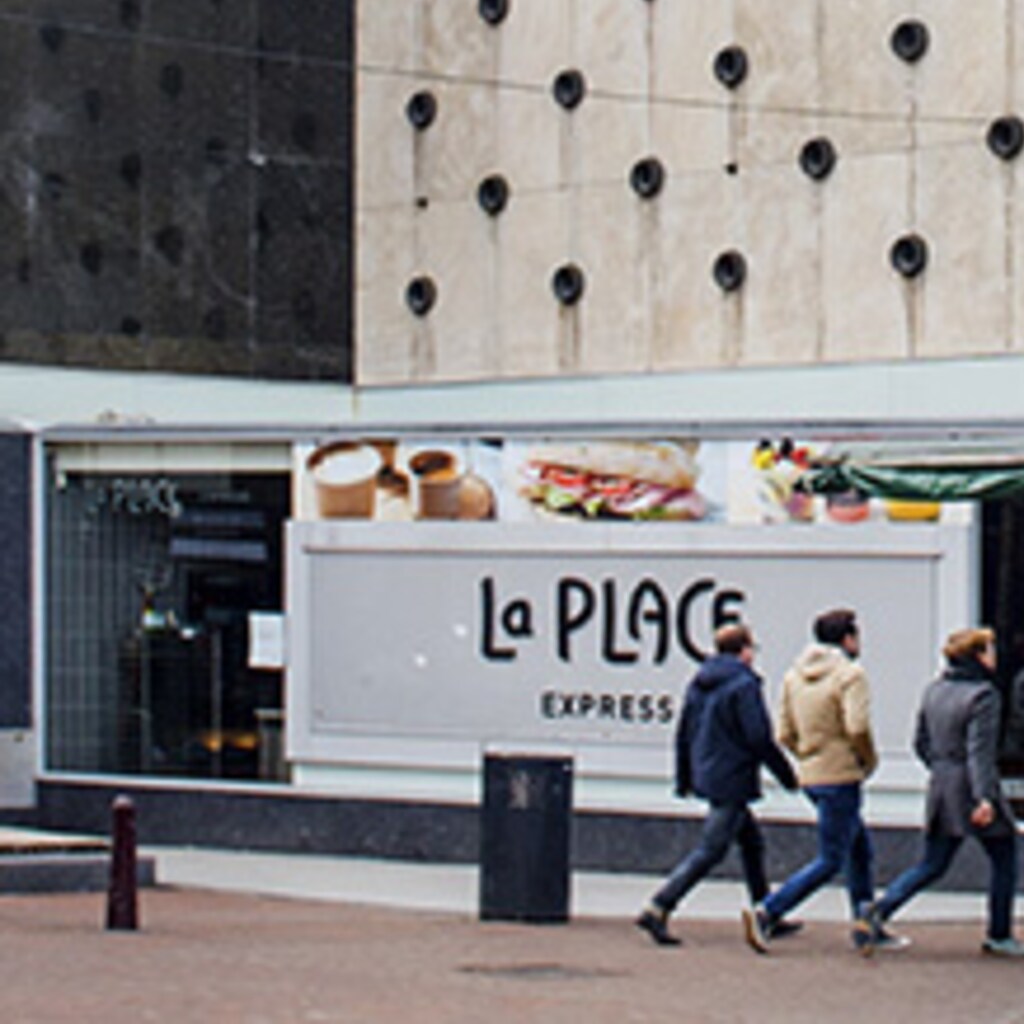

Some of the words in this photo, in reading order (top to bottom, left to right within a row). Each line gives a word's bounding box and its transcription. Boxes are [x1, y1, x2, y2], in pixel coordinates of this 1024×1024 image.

[480, 576, 534, 661] La
[557, 576, 746, 665] PLACE
[541, 691, 674, 723] EXPRESS
